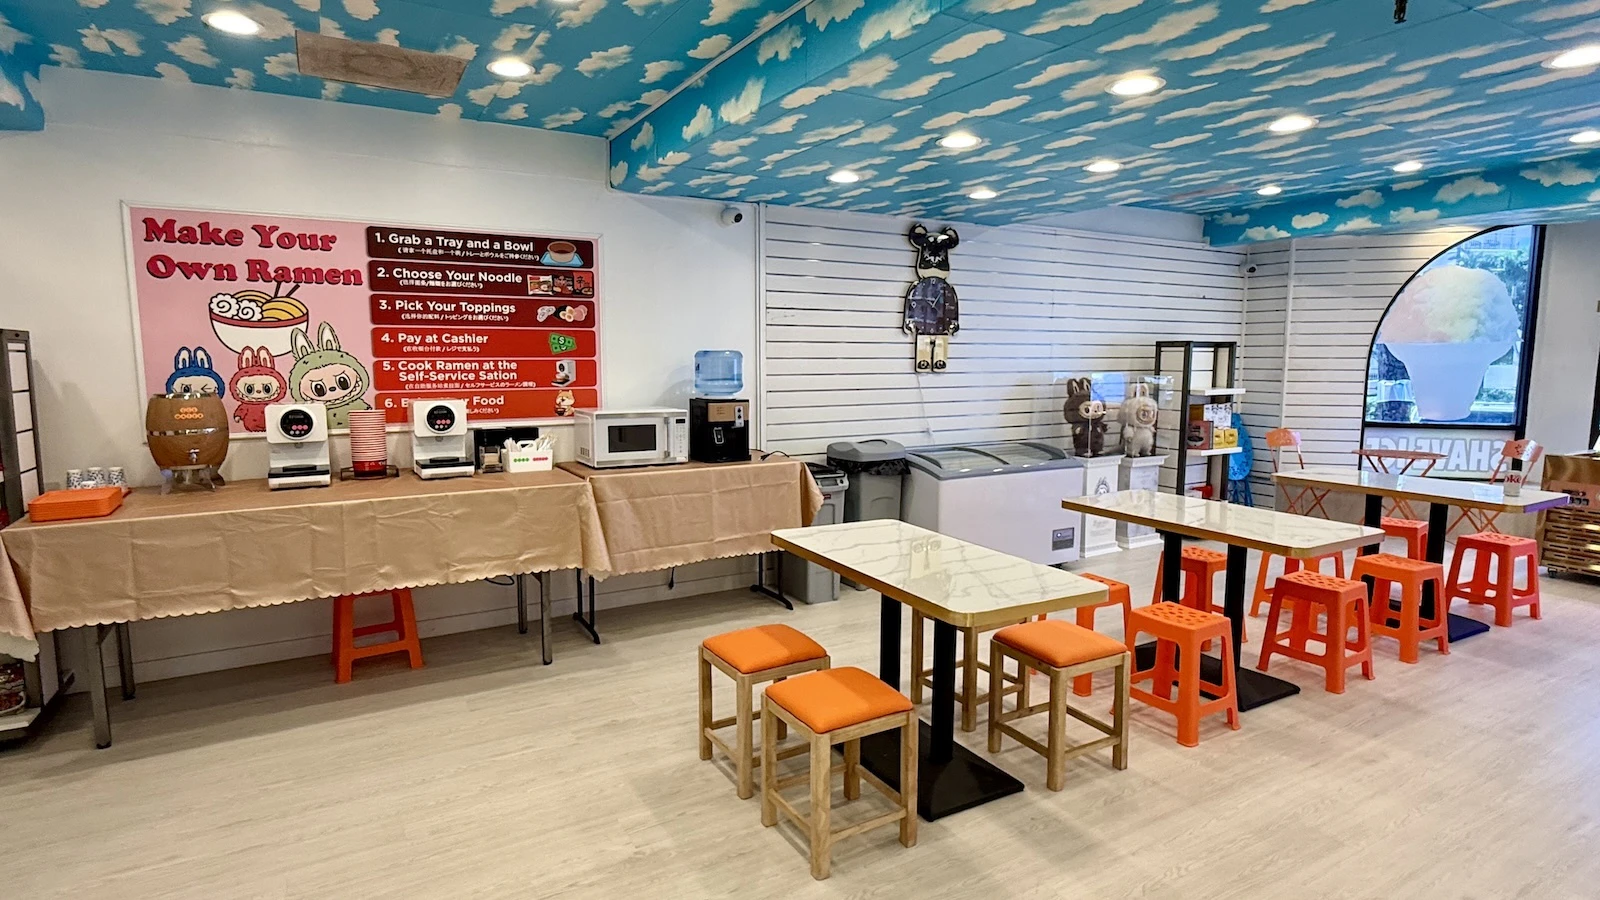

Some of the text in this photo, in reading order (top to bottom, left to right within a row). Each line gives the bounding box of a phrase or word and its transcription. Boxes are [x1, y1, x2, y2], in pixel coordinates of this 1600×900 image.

[142, 217, 337, 251] Make Your
[375, 232, 534, 252] 1. Grab a Tray and a Bowl
[146, 254, 364, 285] Own Ramen
[377, 267, 523, 284] 2. Choose Your Noodle
[379, 299, 516, 315] 3. Pick Your Toppings
[381, 332, 489, 346] 4. Pay at Cashier
[382, 359, 518, 371] 5. Cook Ramen at the
[399, 370, 518, 382] Self-Service Sation
[384, 397, 397, 408] 6.
[473, 395, 505, 406] Food
